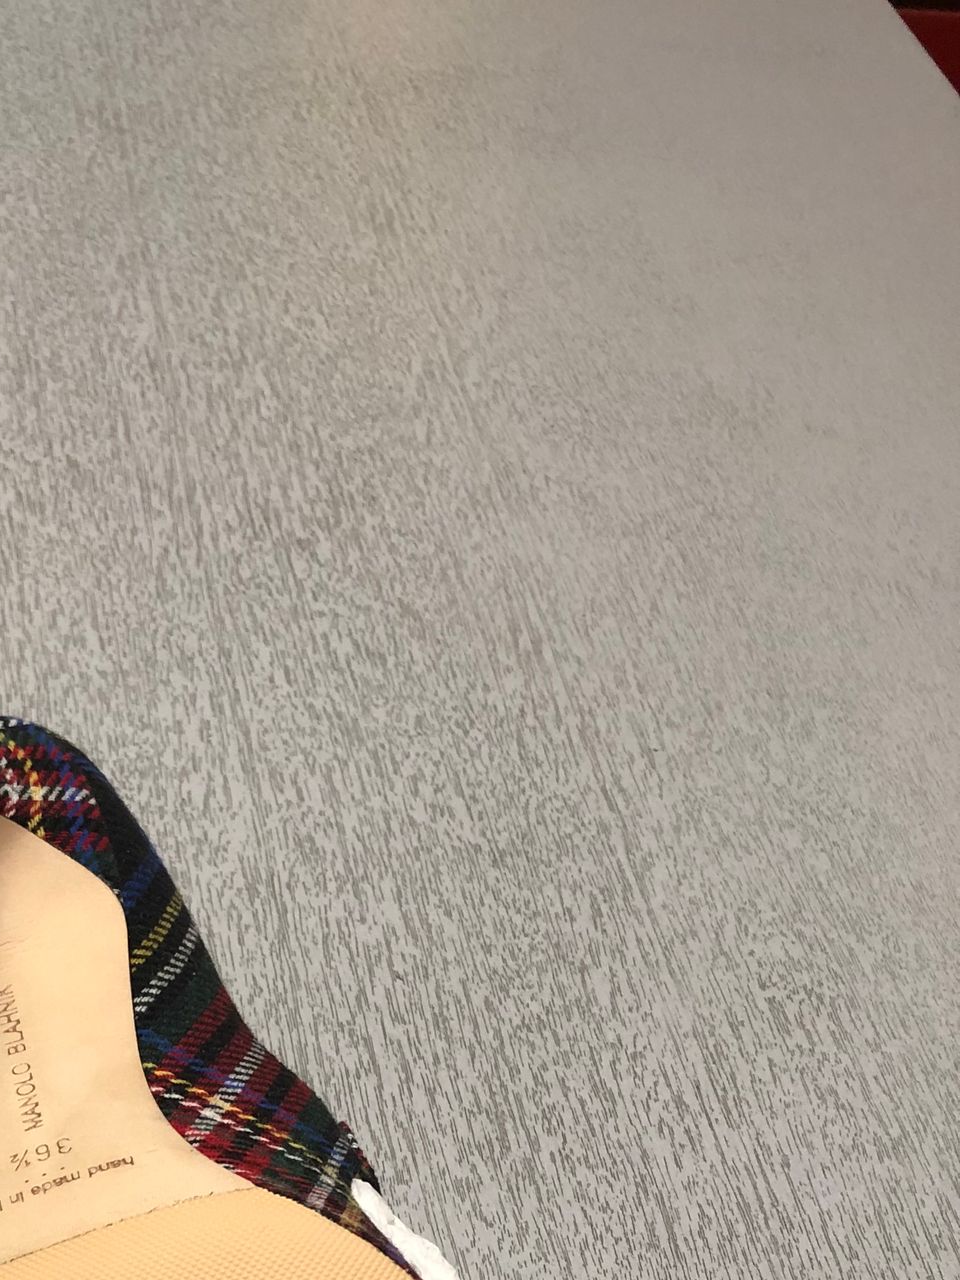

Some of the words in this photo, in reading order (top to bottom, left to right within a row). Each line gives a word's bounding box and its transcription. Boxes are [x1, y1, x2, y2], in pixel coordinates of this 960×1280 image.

[11, 1062, 43, 1132] MANOLO
[88, 1155, 135, 1176] hand
[30, 1170, 80, 1196] made
[9, 1190, 25, 1205] in
